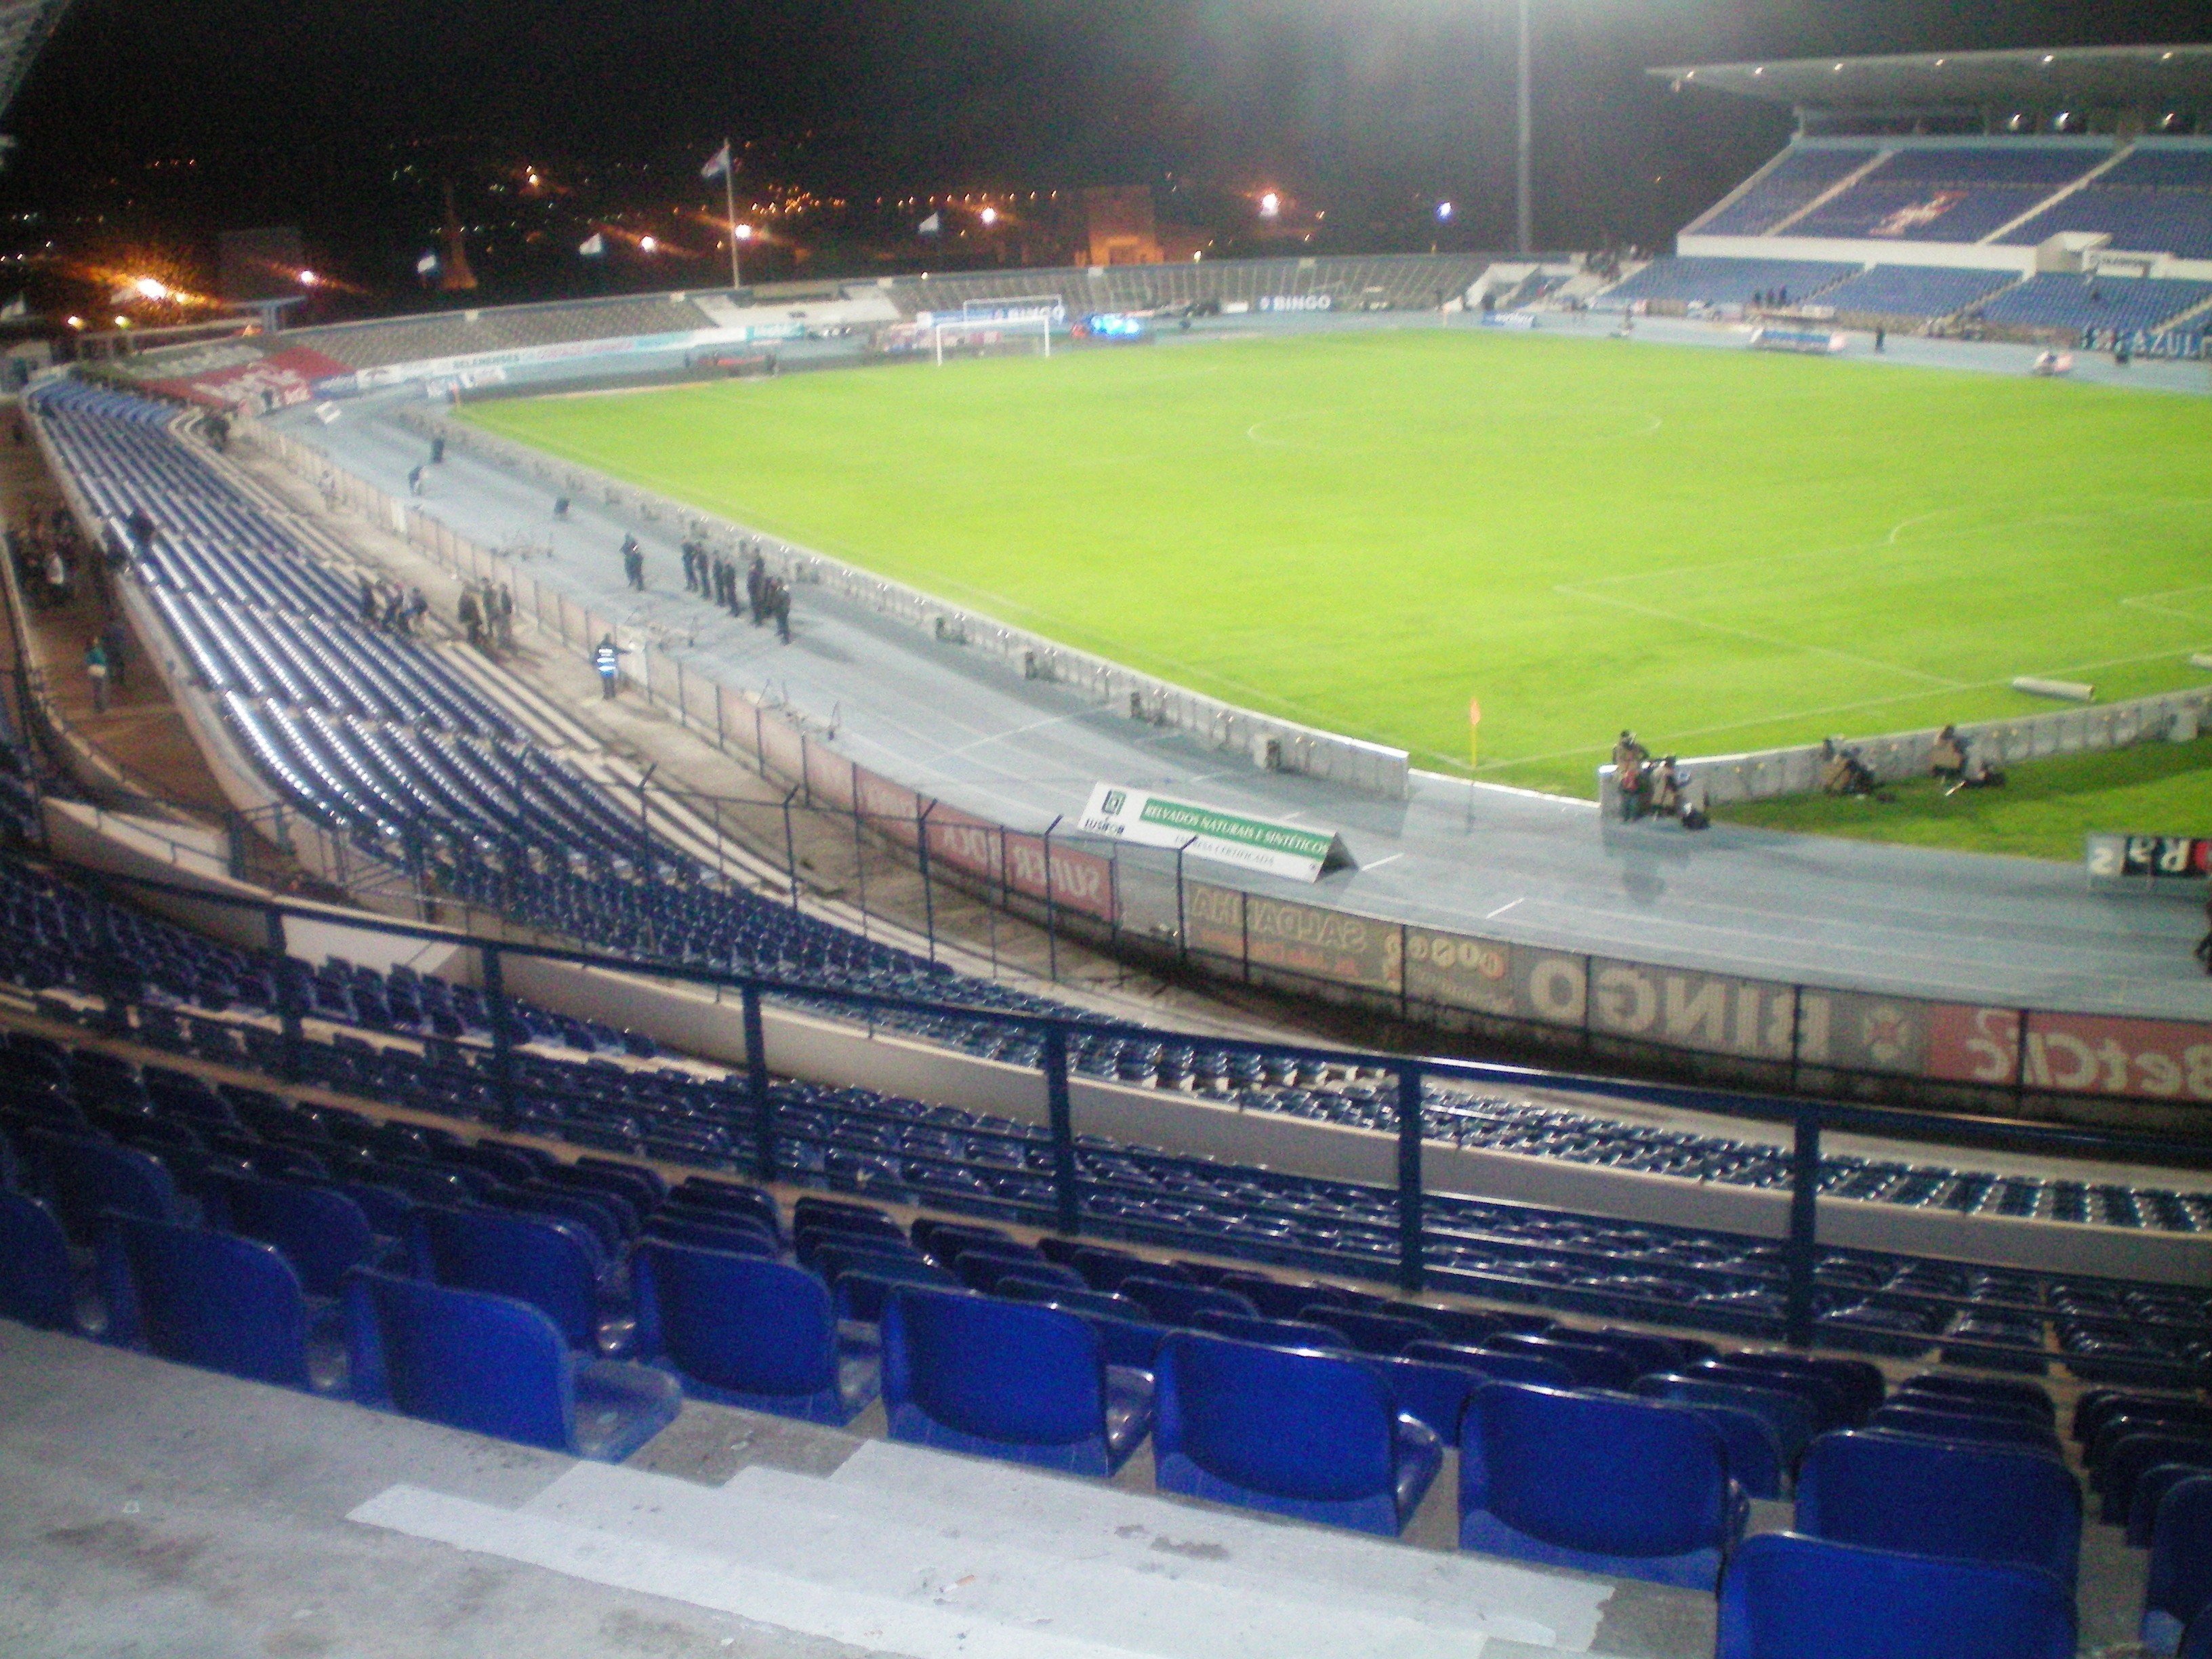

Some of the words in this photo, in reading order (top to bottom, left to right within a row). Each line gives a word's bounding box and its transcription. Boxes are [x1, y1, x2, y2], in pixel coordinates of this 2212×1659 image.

[1273, 294, 1331, 310] BINGO
[1145, 804, 1200, 827] RELVADOS
[1200, 816, 1255, 839] NATURAIS
